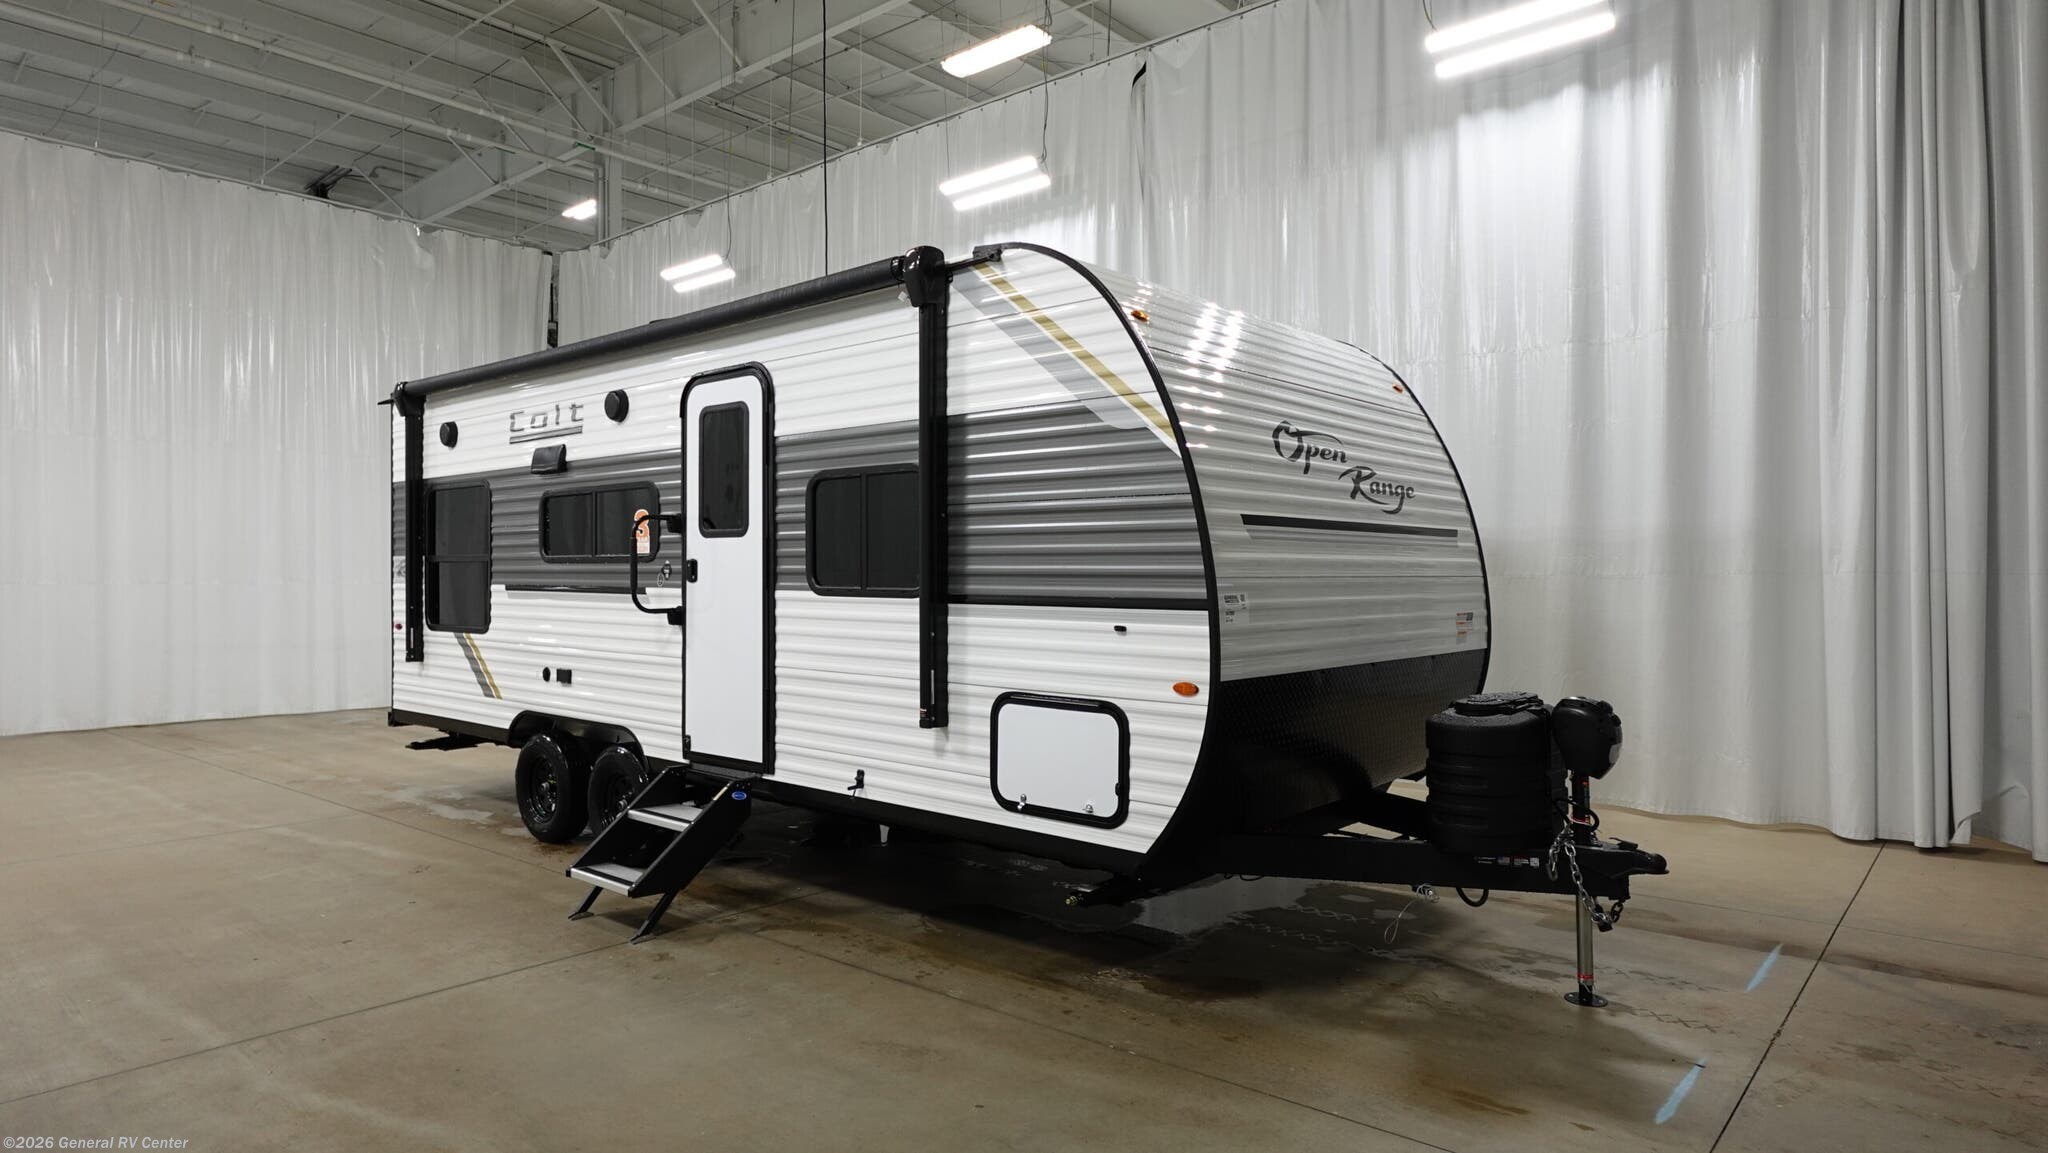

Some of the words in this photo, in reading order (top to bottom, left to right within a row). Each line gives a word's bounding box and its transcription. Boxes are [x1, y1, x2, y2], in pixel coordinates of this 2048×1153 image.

[510, 404, 584, 432] Colt
[1272, 420, 1348, 475] Open
[1338, 465, 1416, 515] Range
